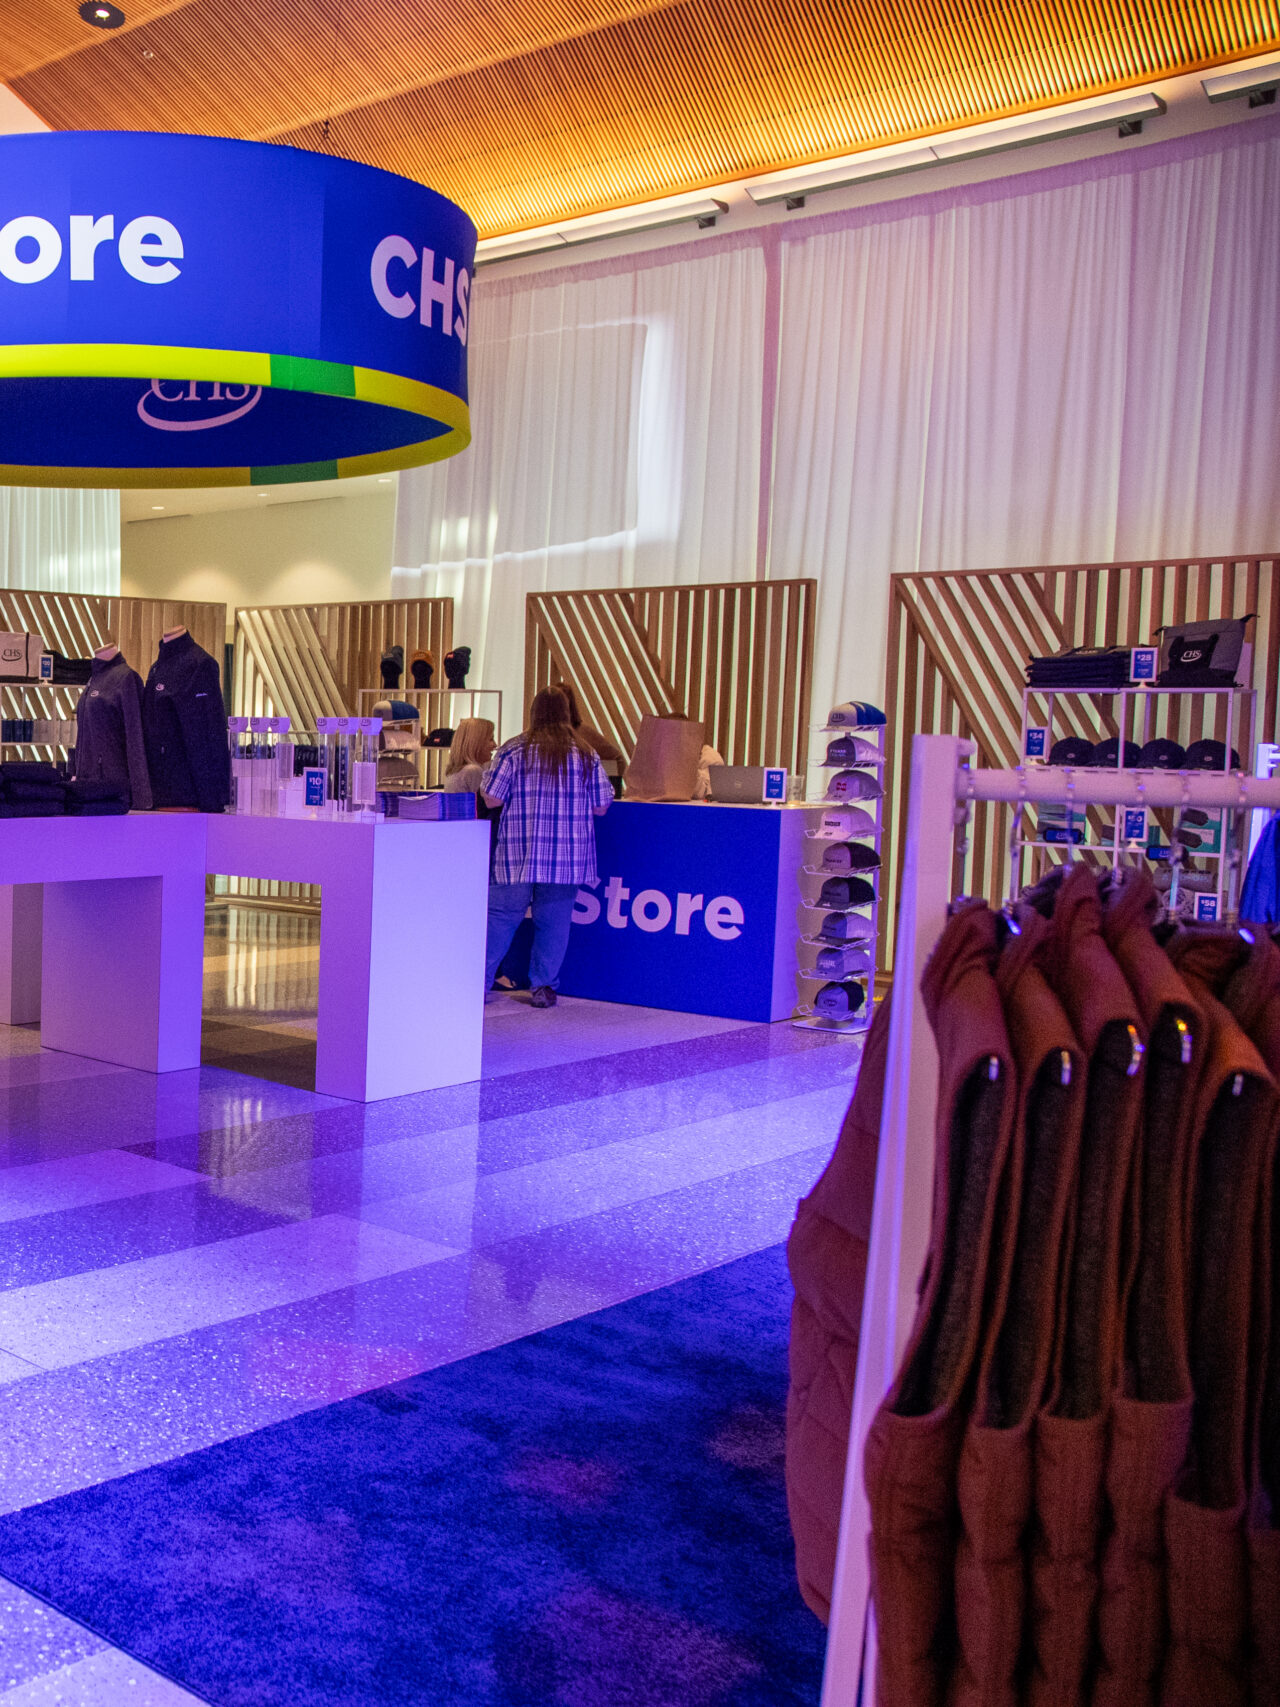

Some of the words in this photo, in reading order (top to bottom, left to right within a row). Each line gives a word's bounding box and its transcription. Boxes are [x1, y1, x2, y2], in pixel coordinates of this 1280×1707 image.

[370, 234, 469, 347] CHS
[3, 649, 21, 657] CHS
[1183, 650, 1201, 659] CHS
[309, 777, 322, 785] $10
[1201, 899, 1216, 907] $58
[570, 876, 745, 941] Store
